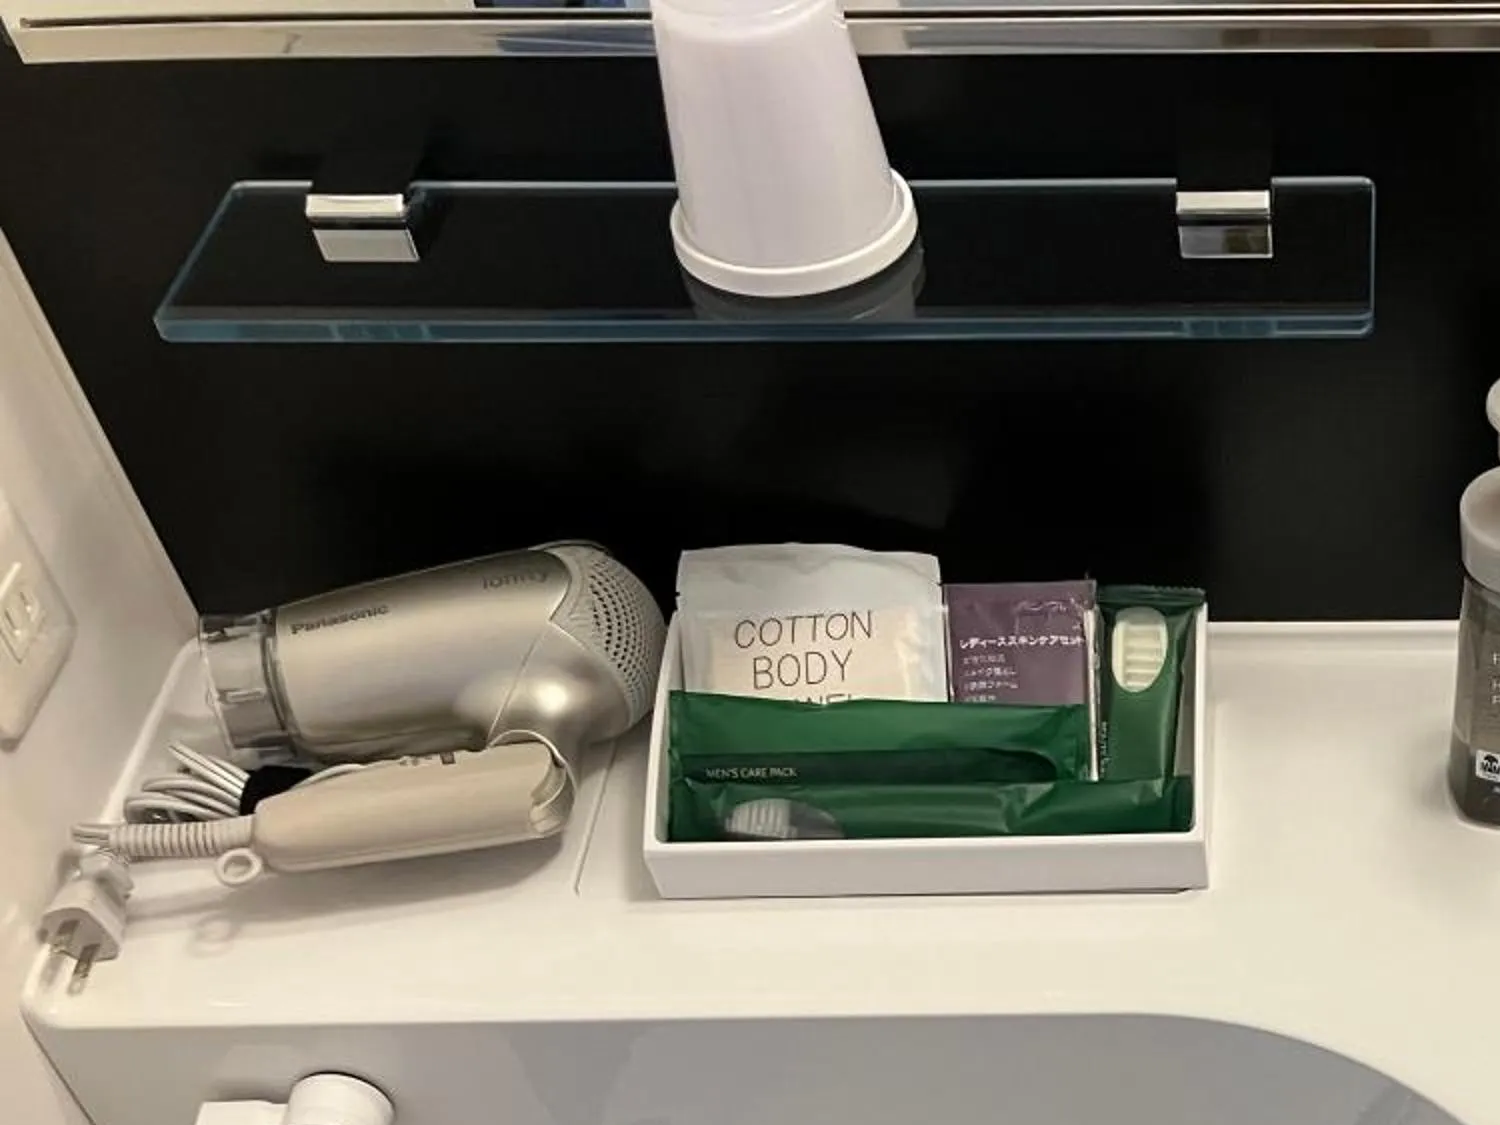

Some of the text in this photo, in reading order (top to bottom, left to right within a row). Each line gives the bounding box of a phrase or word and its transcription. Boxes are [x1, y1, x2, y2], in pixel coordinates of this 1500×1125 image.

[291, 604, 390, 635] Panasonic
[735, 610, 872, 649] COTTON
[753, 649, 853, 690] BODY
